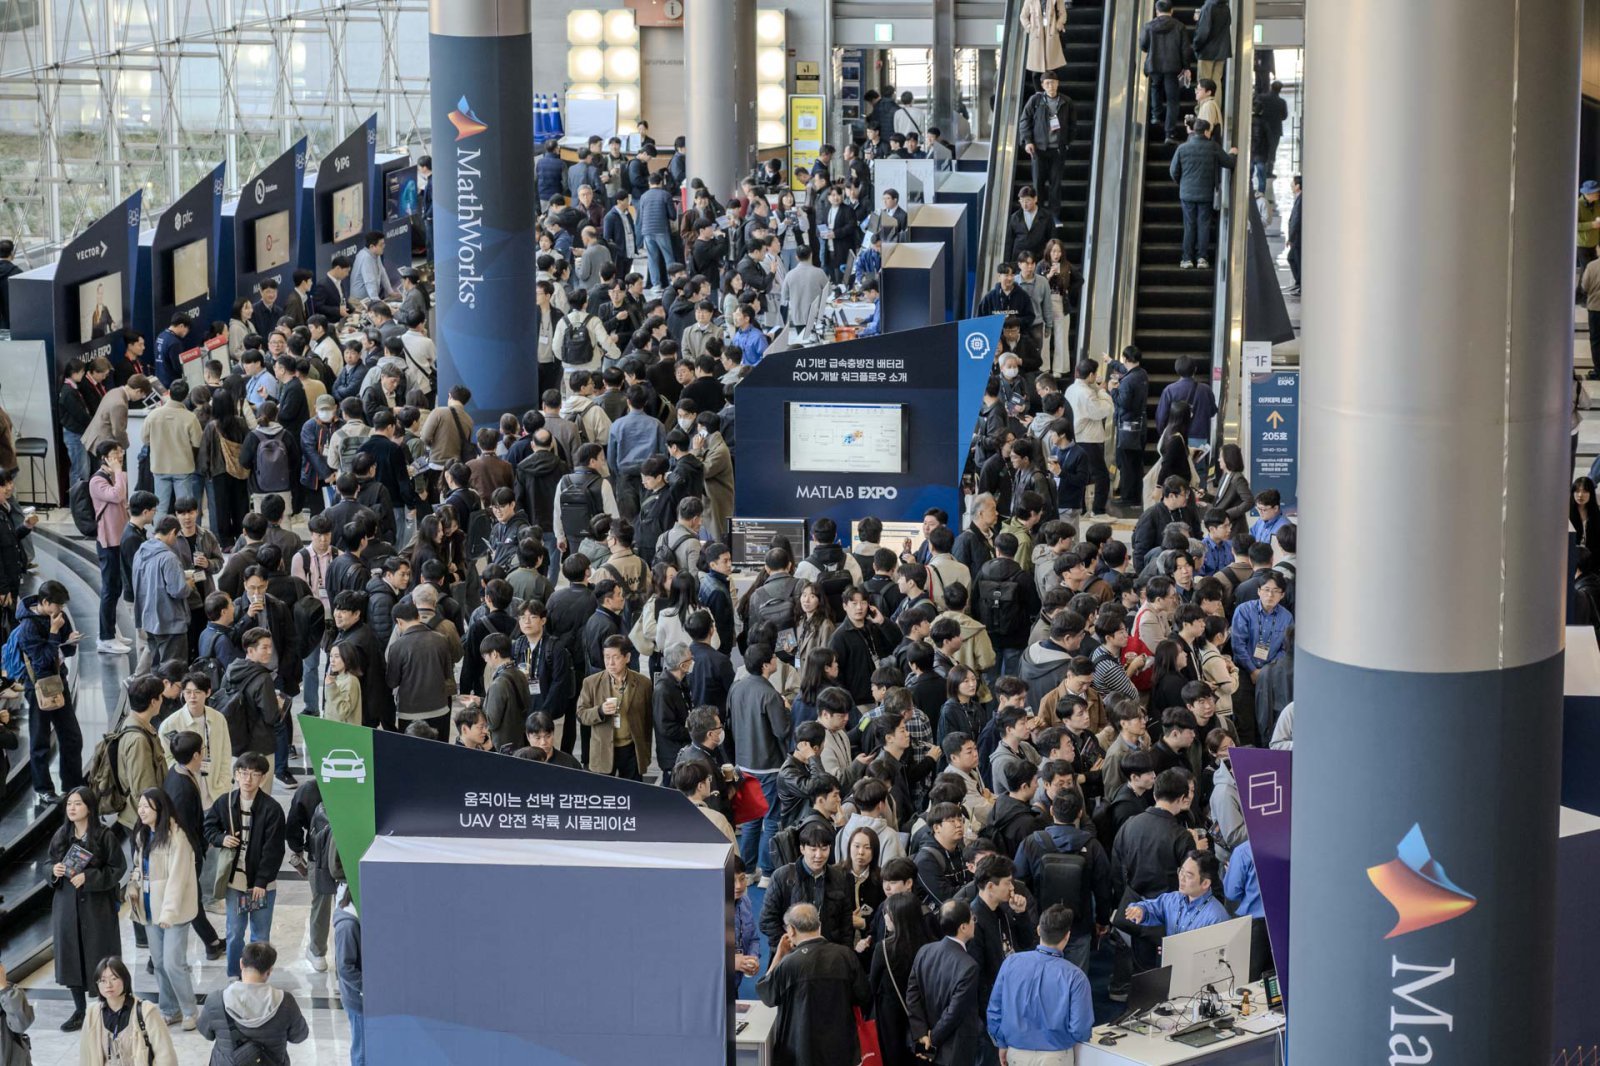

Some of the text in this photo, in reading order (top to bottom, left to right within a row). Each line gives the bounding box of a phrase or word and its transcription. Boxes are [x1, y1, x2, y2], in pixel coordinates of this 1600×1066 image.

[340, 156, 351, 170] IPG
[183, 210, 194, 228] ptc
[457, 147, 484, 304] MathWorks
[76, 246, 100, 260] VECTOR
[795, 358, 904, 369] AI 기반 급속충방전 배터리
[1255, 355, 1268, 367] 1F
[793, 371, 907, 383] ROM 개발 워크플로우 소개
[1262, 432, 1288, 441] 205호
[795, 485, 898, 501] MATLAB EXPO
[464, 792, 631, 811] 움직이는 선박 갑판으로의
[459, 813, 637, 832] UAV 안전 착륙 시뮬레이션
